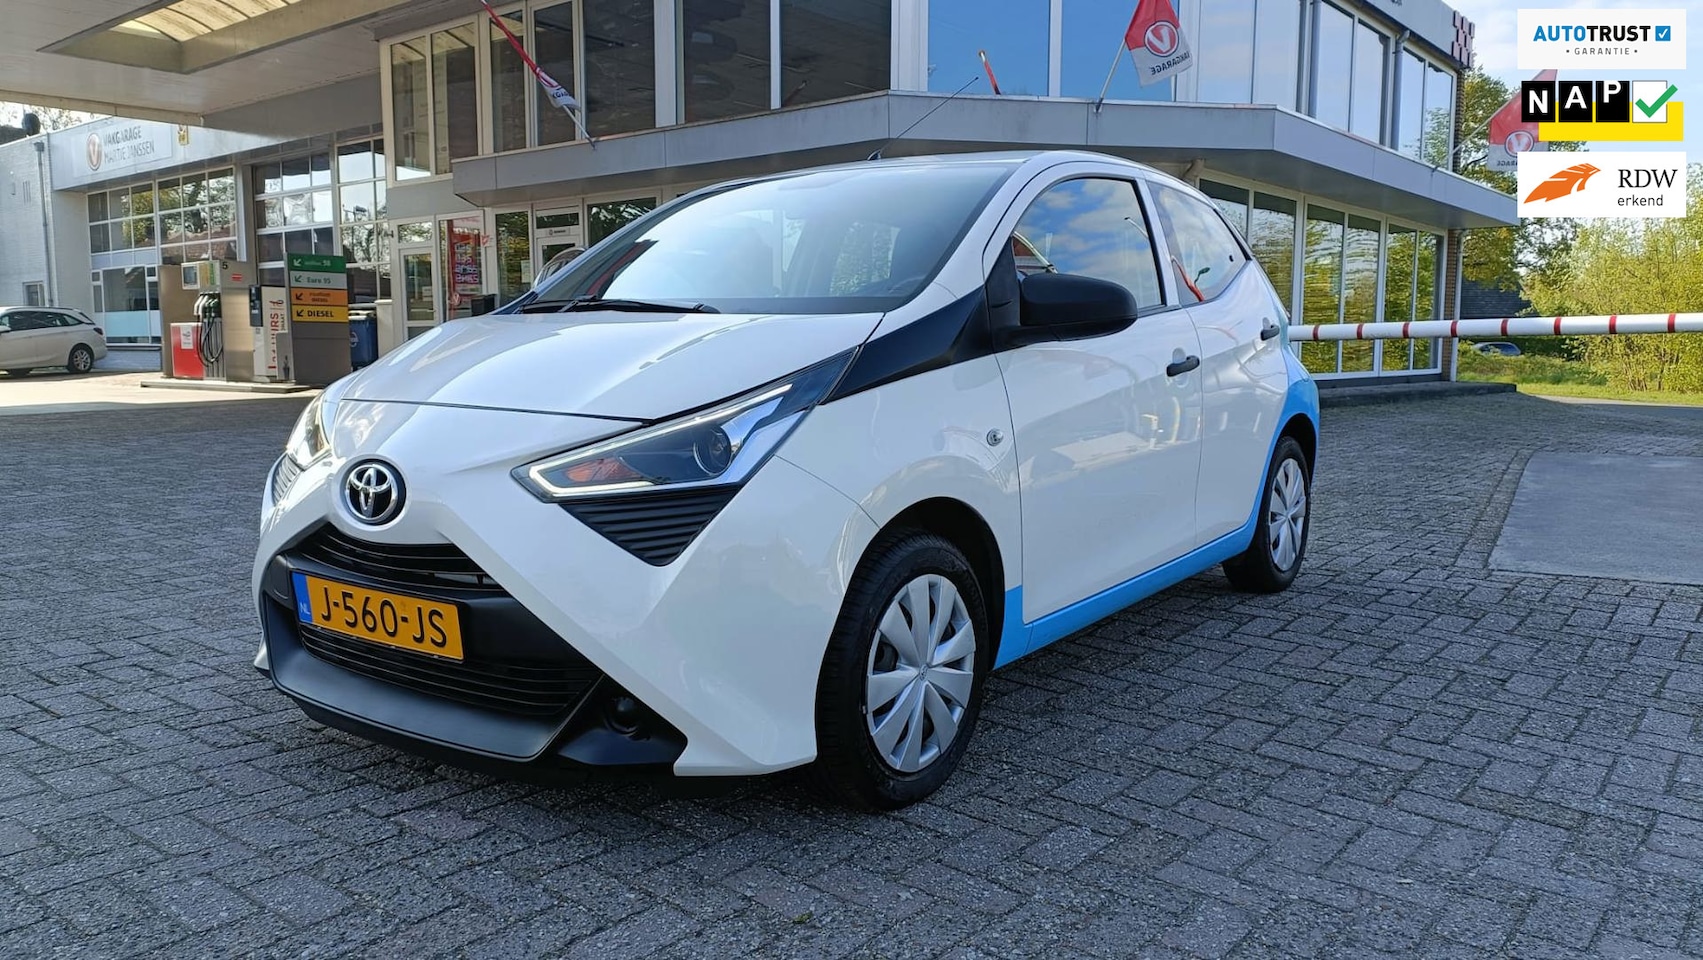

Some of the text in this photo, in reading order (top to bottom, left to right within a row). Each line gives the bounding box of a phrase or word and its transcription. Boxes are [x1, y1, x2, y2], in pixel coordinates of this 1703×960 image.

[103, 126, 142, 147] VAKGARAGE
[126, 140, 155, 160] JANSSEN
[222, 261, 228, 270] 5
[306, 276, 322, 284] Euro
[307, 310, 334, 318] DIESEL
[300, 602, 310, 615] NL
[322, 587, 447, 648] J-560-JS
